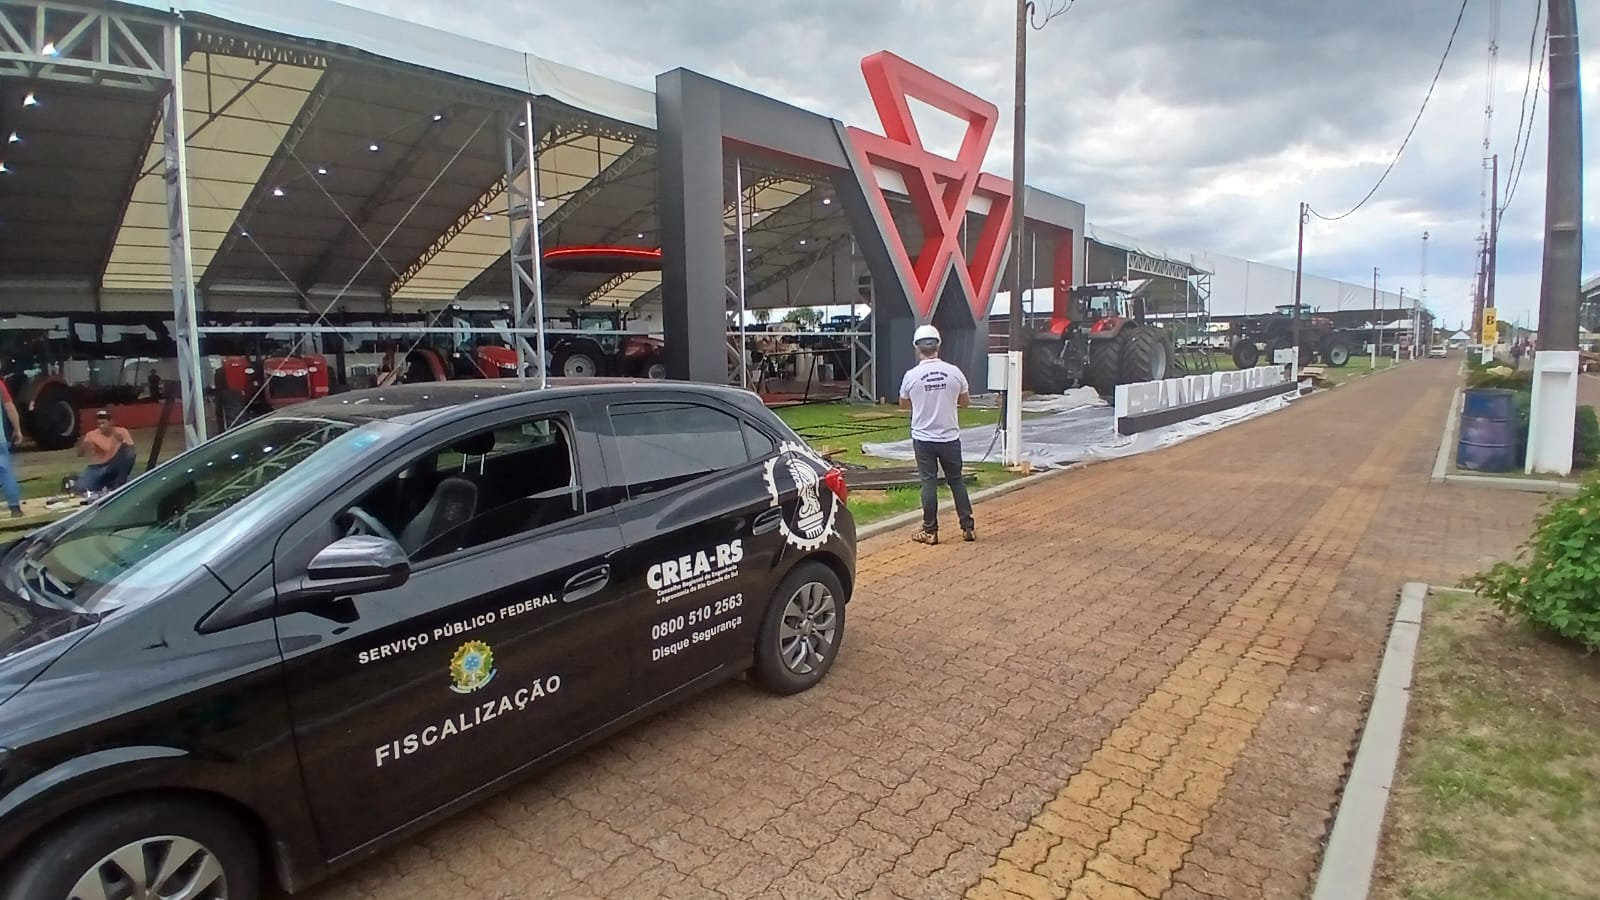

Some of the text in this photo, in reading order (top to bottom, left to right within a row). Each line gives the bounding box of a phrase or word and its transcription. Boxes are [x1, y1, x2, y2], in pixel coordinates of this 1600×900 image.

[1486, 315, 1495, 326] B
[646, 539, 744, 590] CREA-RS
[358, 593, 557, 664] SERVIÇO PÚBLICO FEDERAL
[651, 593, 743, 640] 0800 510 2563
[652, 615, 743, 661] Disque Segurança
[375, 675, 561, 767] FISCALIZAÇÃO
